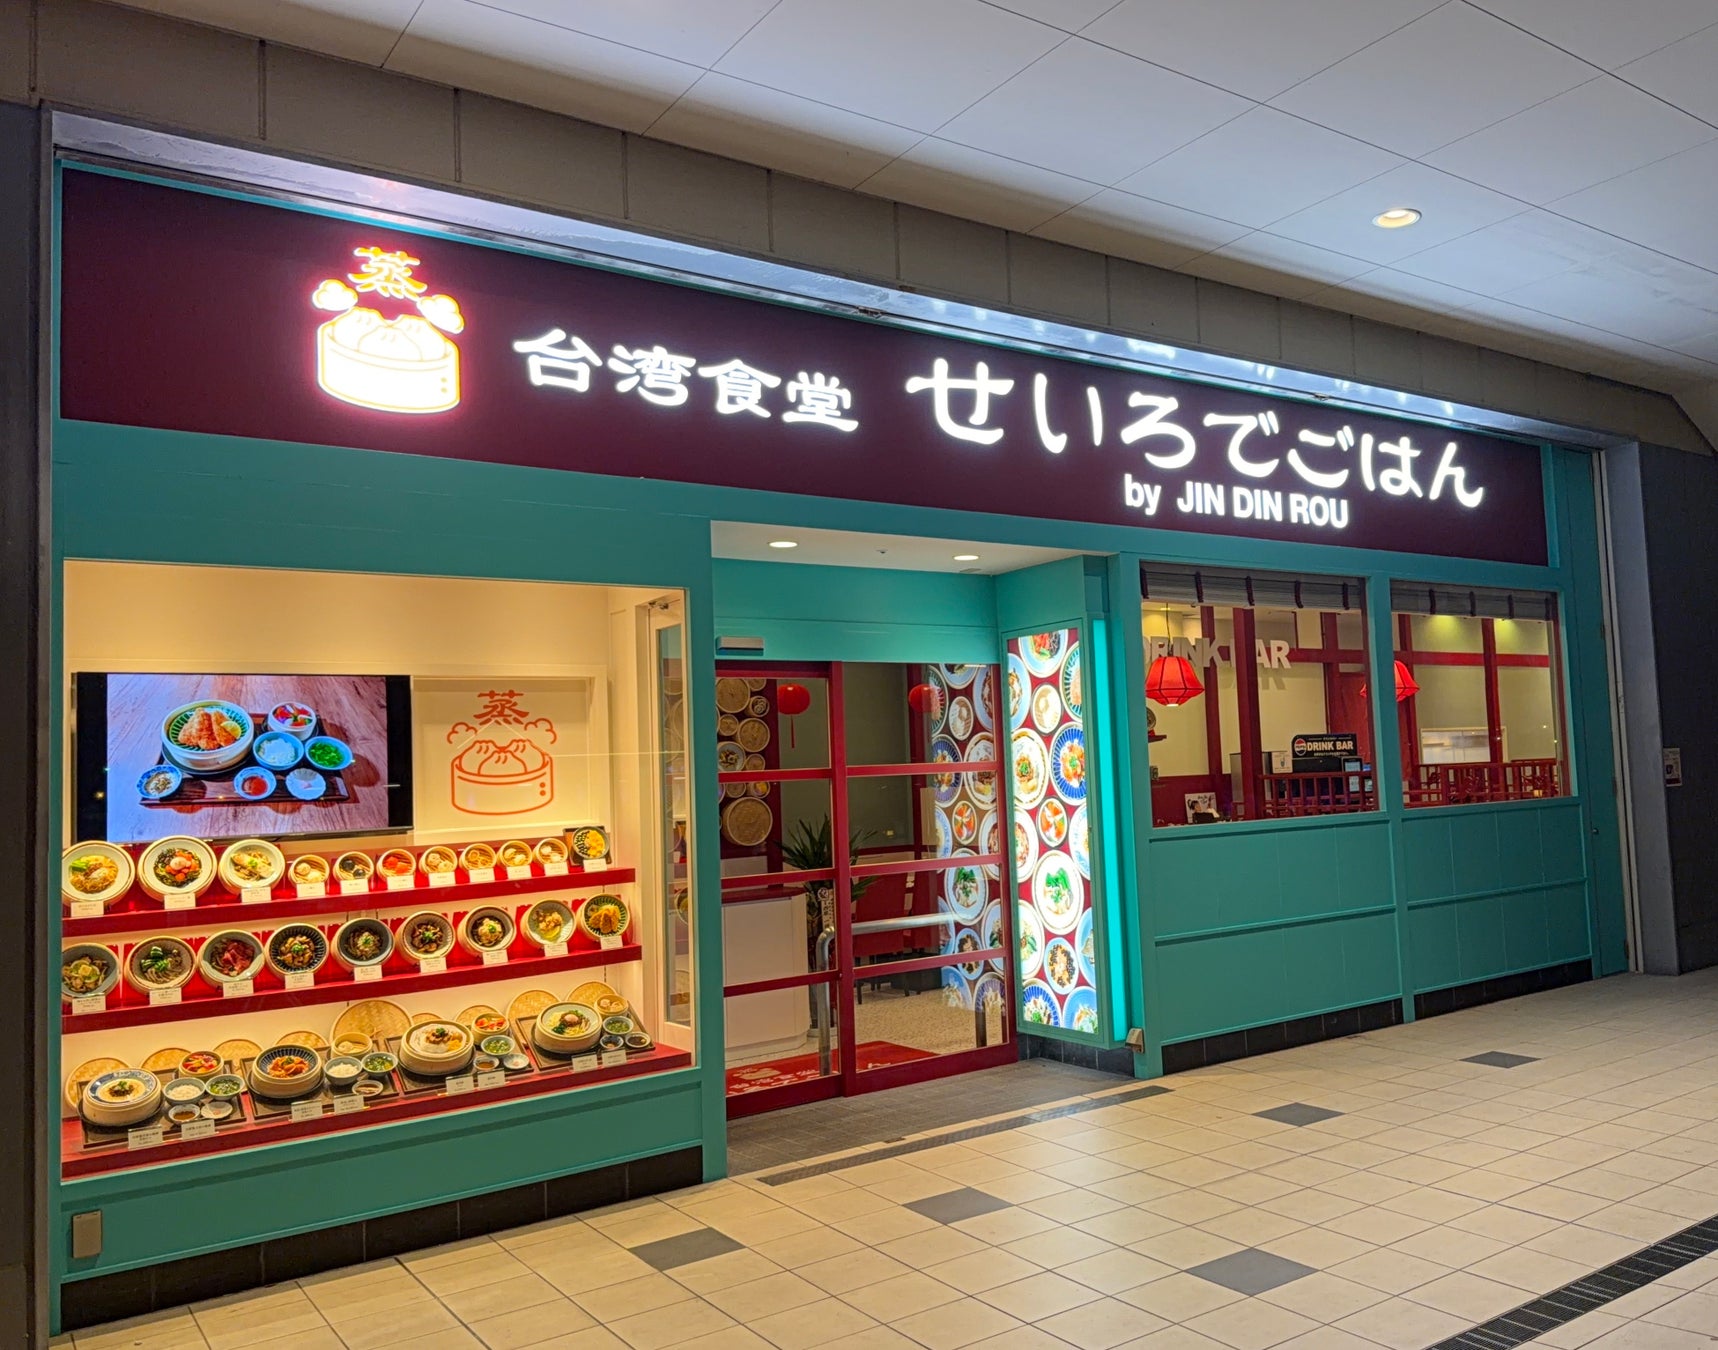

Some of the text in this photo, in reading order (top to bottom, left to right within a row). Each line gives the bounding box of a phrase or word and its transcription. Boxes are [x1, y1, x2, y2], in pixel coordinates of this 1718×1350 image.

[347, 246, 428, 302] 蒸
[513, 328, 1484, 508] 台湾食堂 せいろでごはん
[1124, 473, 1349, 529] by JIN DIN ROU
[1229, 638, 1291, 669] AR
[473, 689, 529, 726] 蒸
[1307, 740, 1354, 751] DRINK BAR
